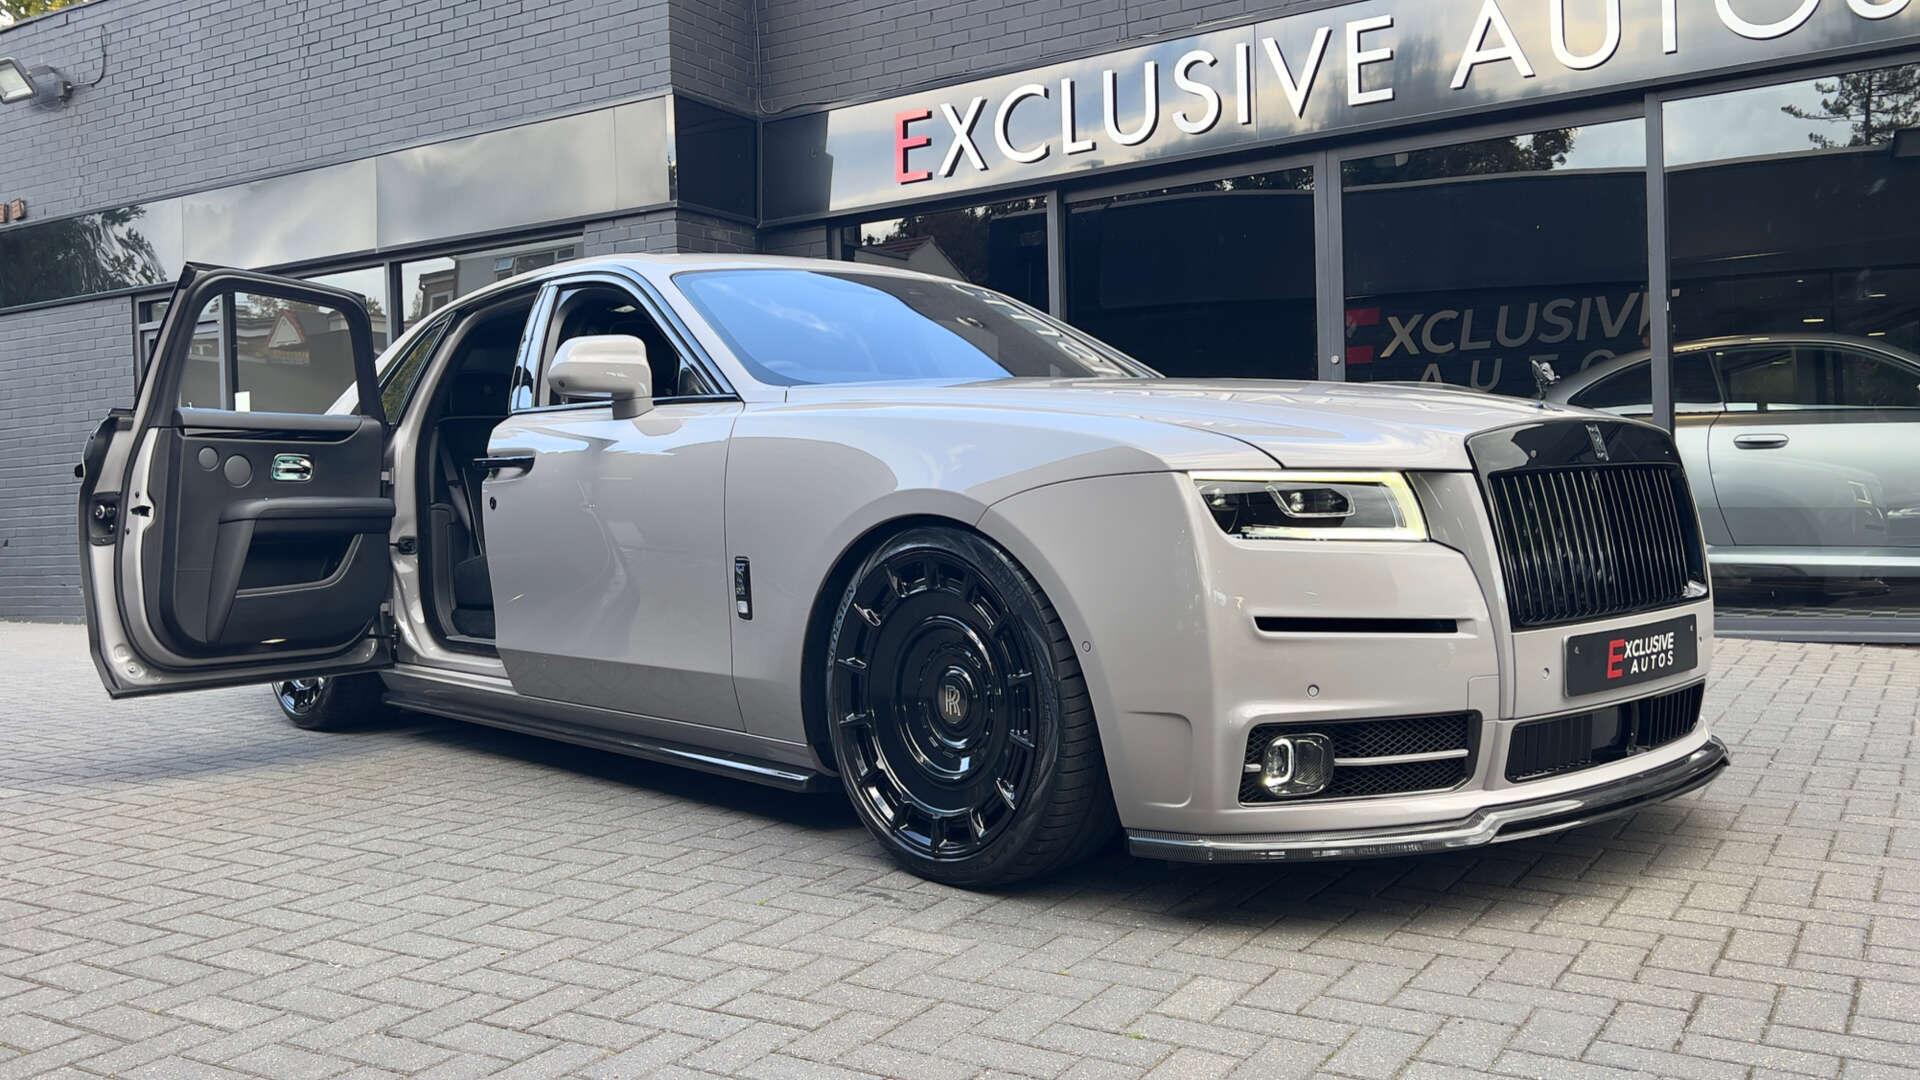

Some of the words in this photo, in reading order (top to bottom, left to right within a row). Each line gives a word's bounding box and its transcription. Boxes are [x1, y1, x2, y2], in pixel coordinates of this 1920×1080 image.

[895, 14, 1394, 184] EXCLUSIVE
[1449, 0, 1910, 90] AUT
[1346, 292, 1652, 364] XCLUSIV
[1607, 632, 1674, 679] EXCLUSIVE
[1630, 651, 1674, 674] AUTOS
